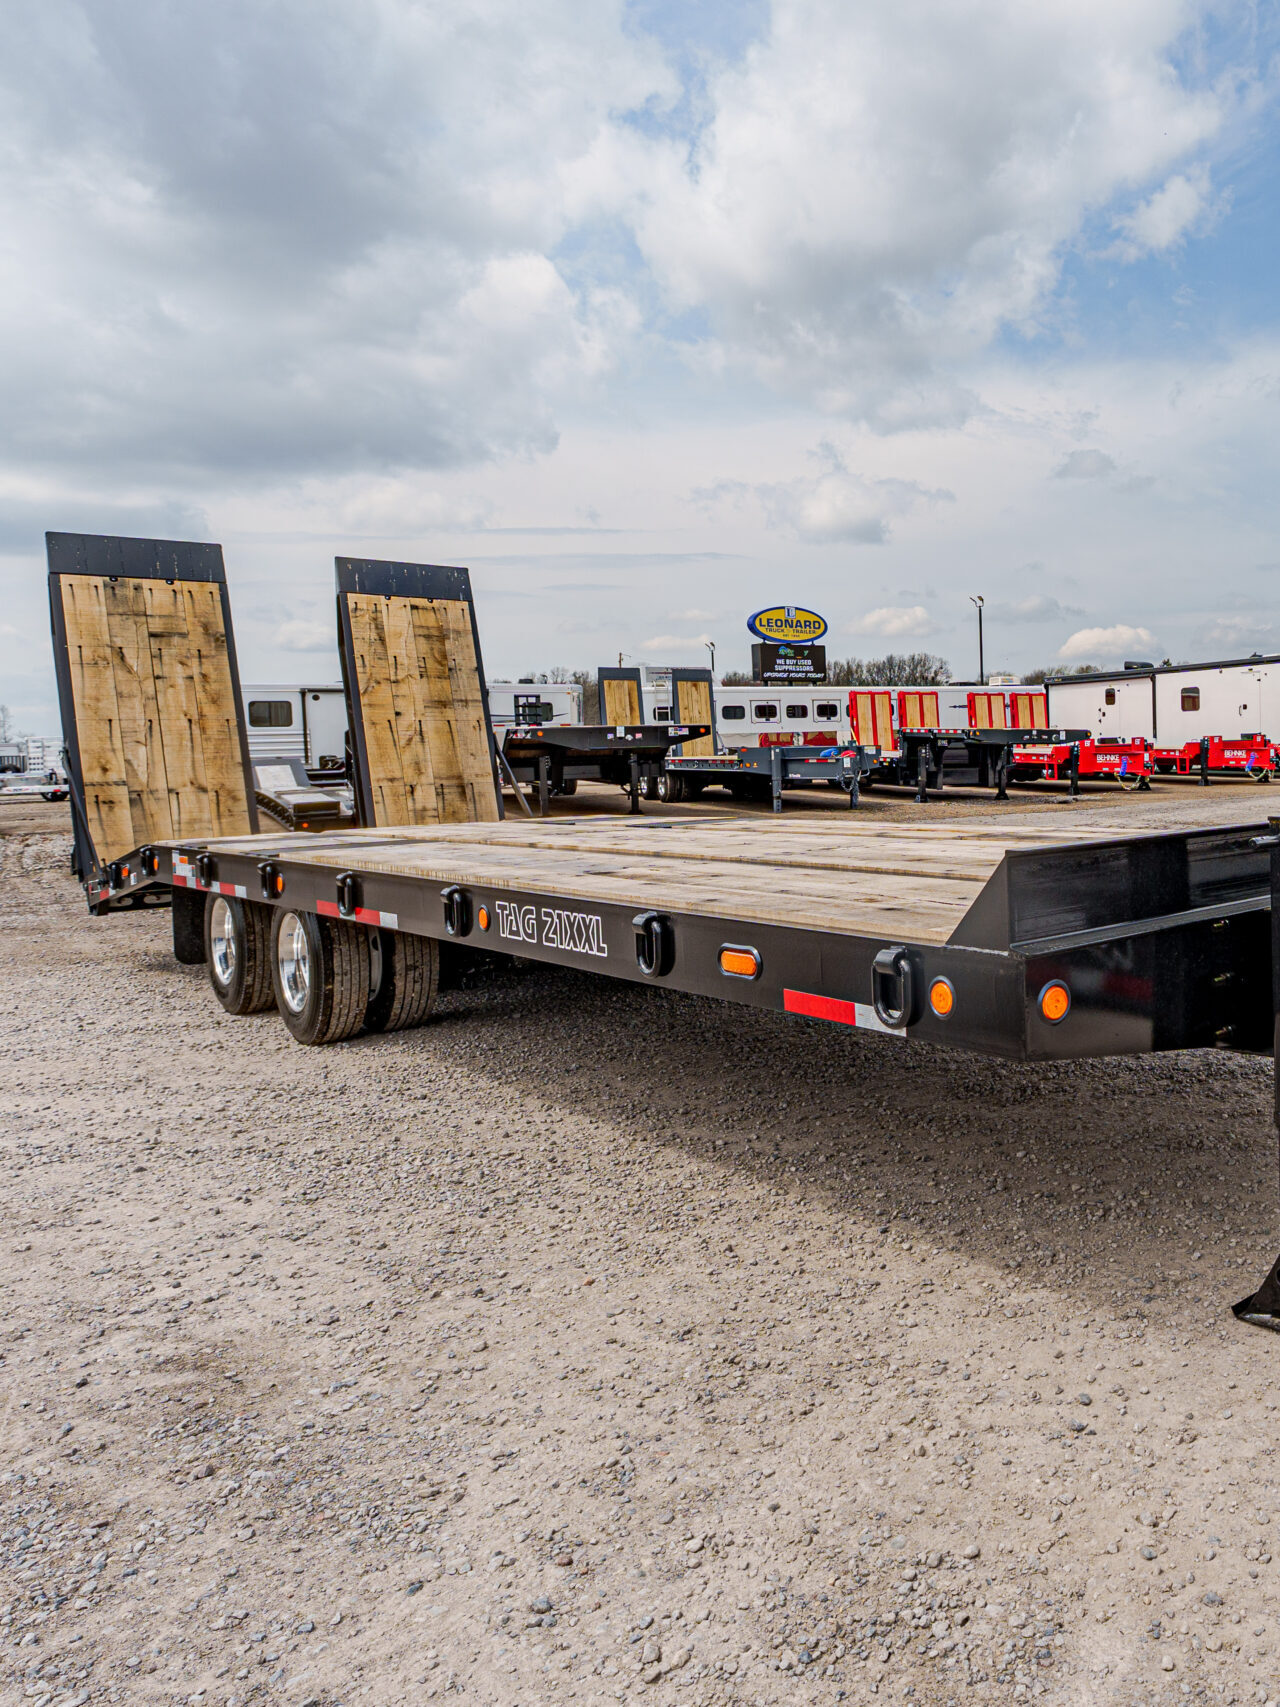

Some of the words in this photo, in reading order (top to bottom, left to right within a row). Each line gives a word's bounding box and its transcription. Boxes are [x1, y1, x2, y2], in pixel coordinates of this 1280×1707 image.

[759, 618, 821, 630] LEONARD
[1096, 753, 1120, 761] BEHNKE
[1224, 749, 1247, 757] BEHNKE
[496, 901, 537, 943] TAG
[541, 908, 608, 957] 21XXL
